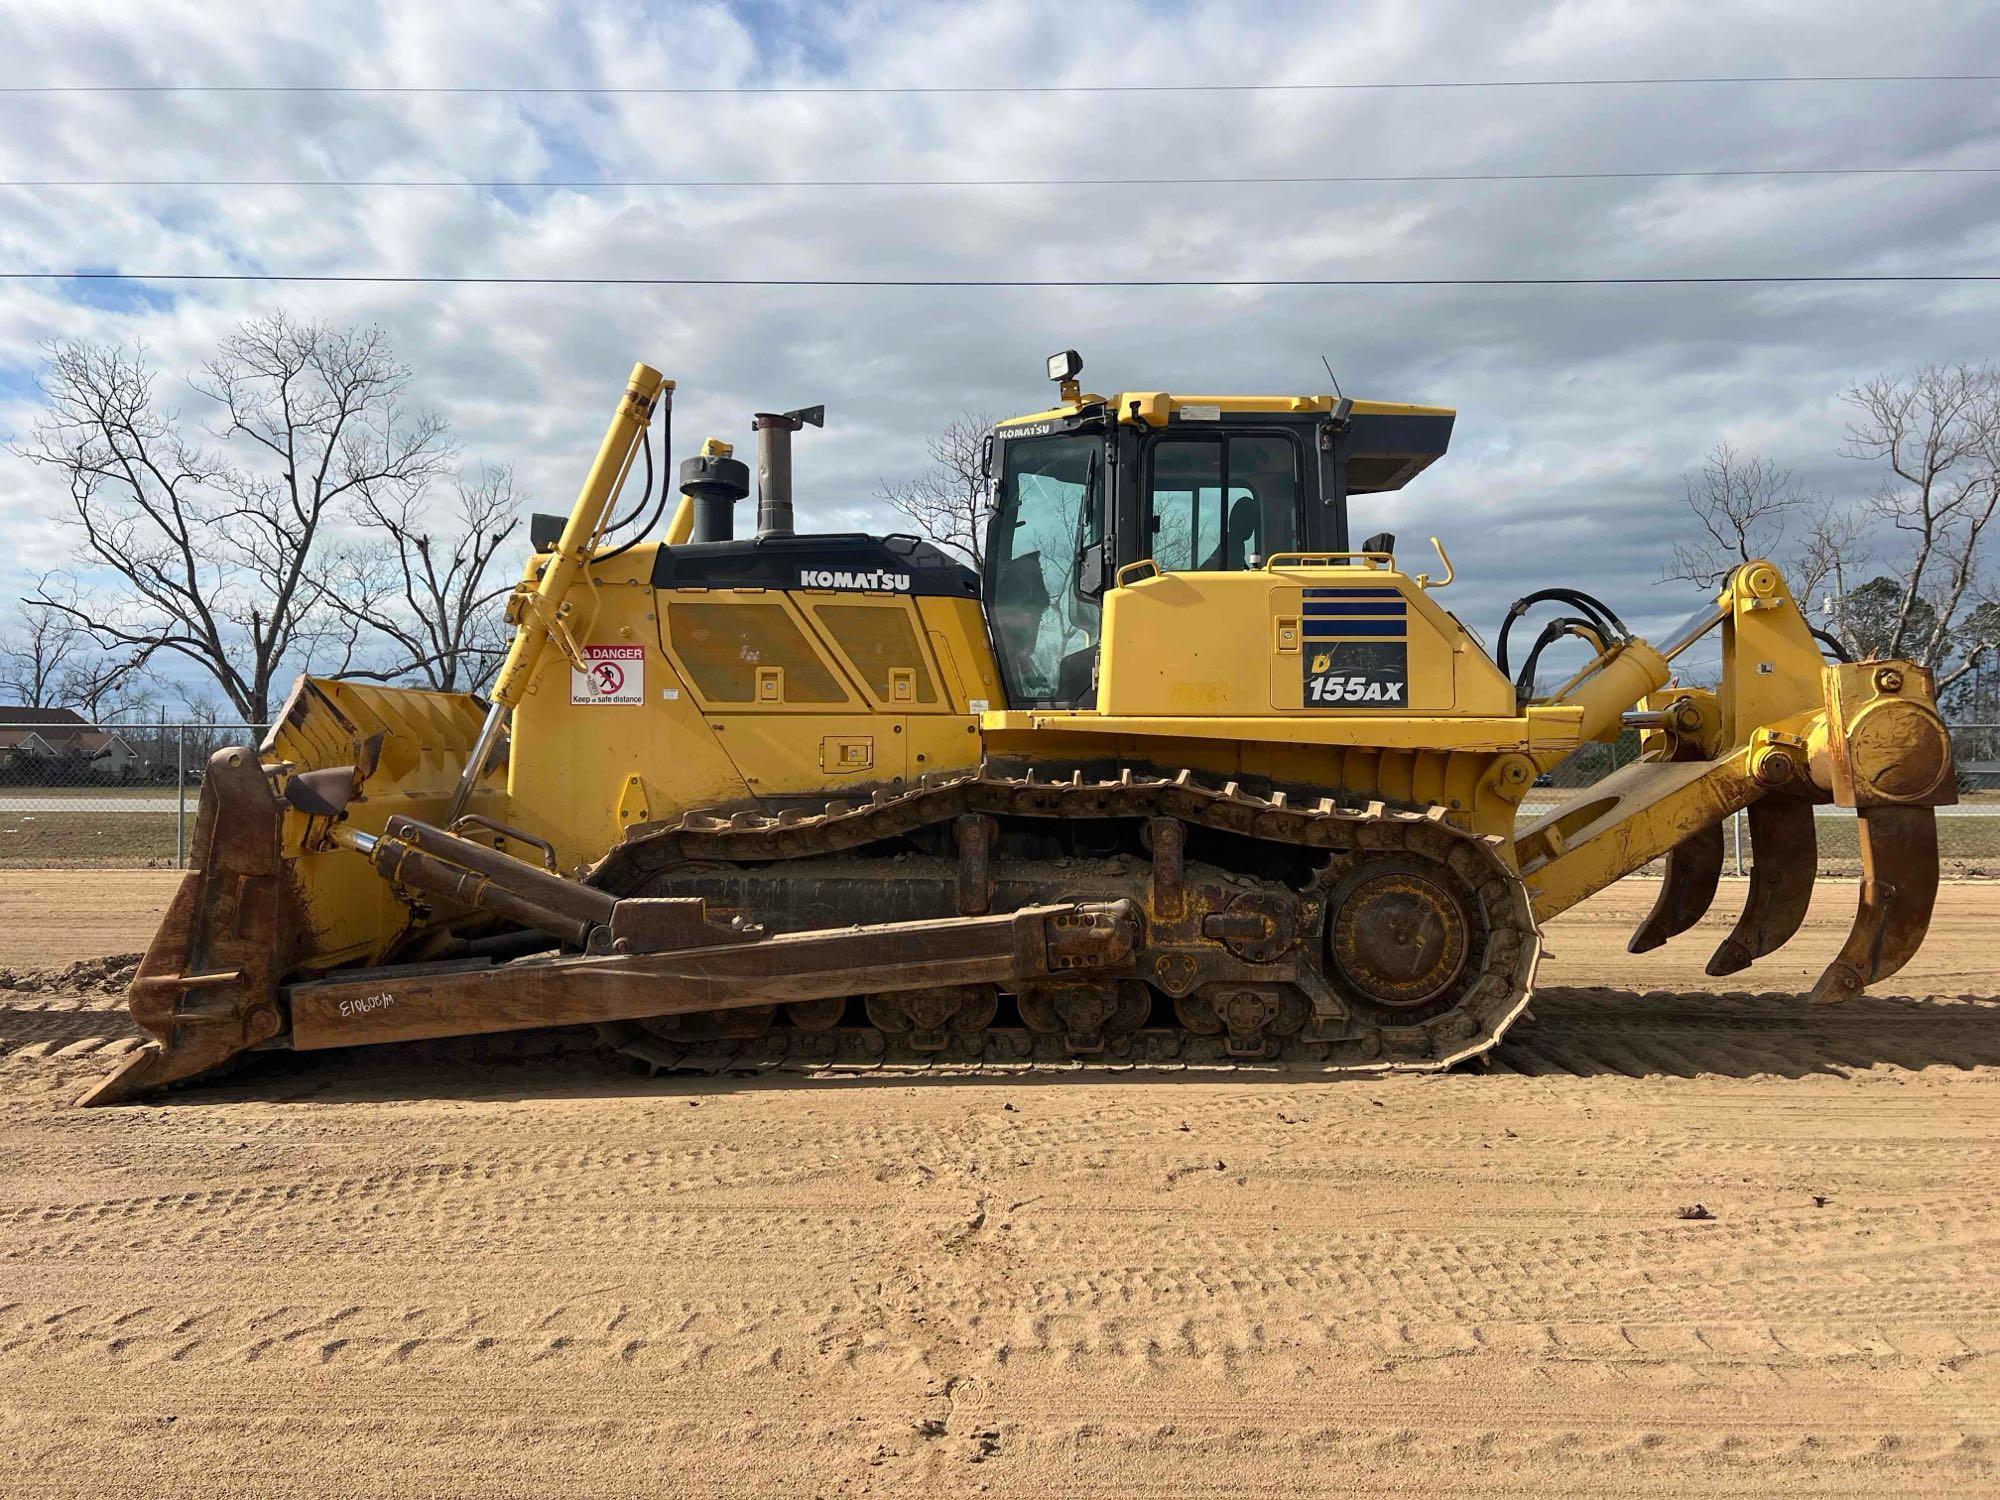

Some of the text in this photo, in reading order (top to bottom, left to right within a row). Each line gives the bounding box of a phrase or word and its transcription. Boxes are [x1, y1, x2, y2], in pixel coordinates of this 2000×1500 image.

[999, 424, 1050, 439] KOMATSU
[801, 569, 910, 591] KOMATSU
[593, 648, 642, 659] DANGER
[1310, 677, 1404, 701] 155AX
[573, 696, 591, 704] Keep
[598, 695, 612, 703] safe
[613, 695, 642, 703] distance
